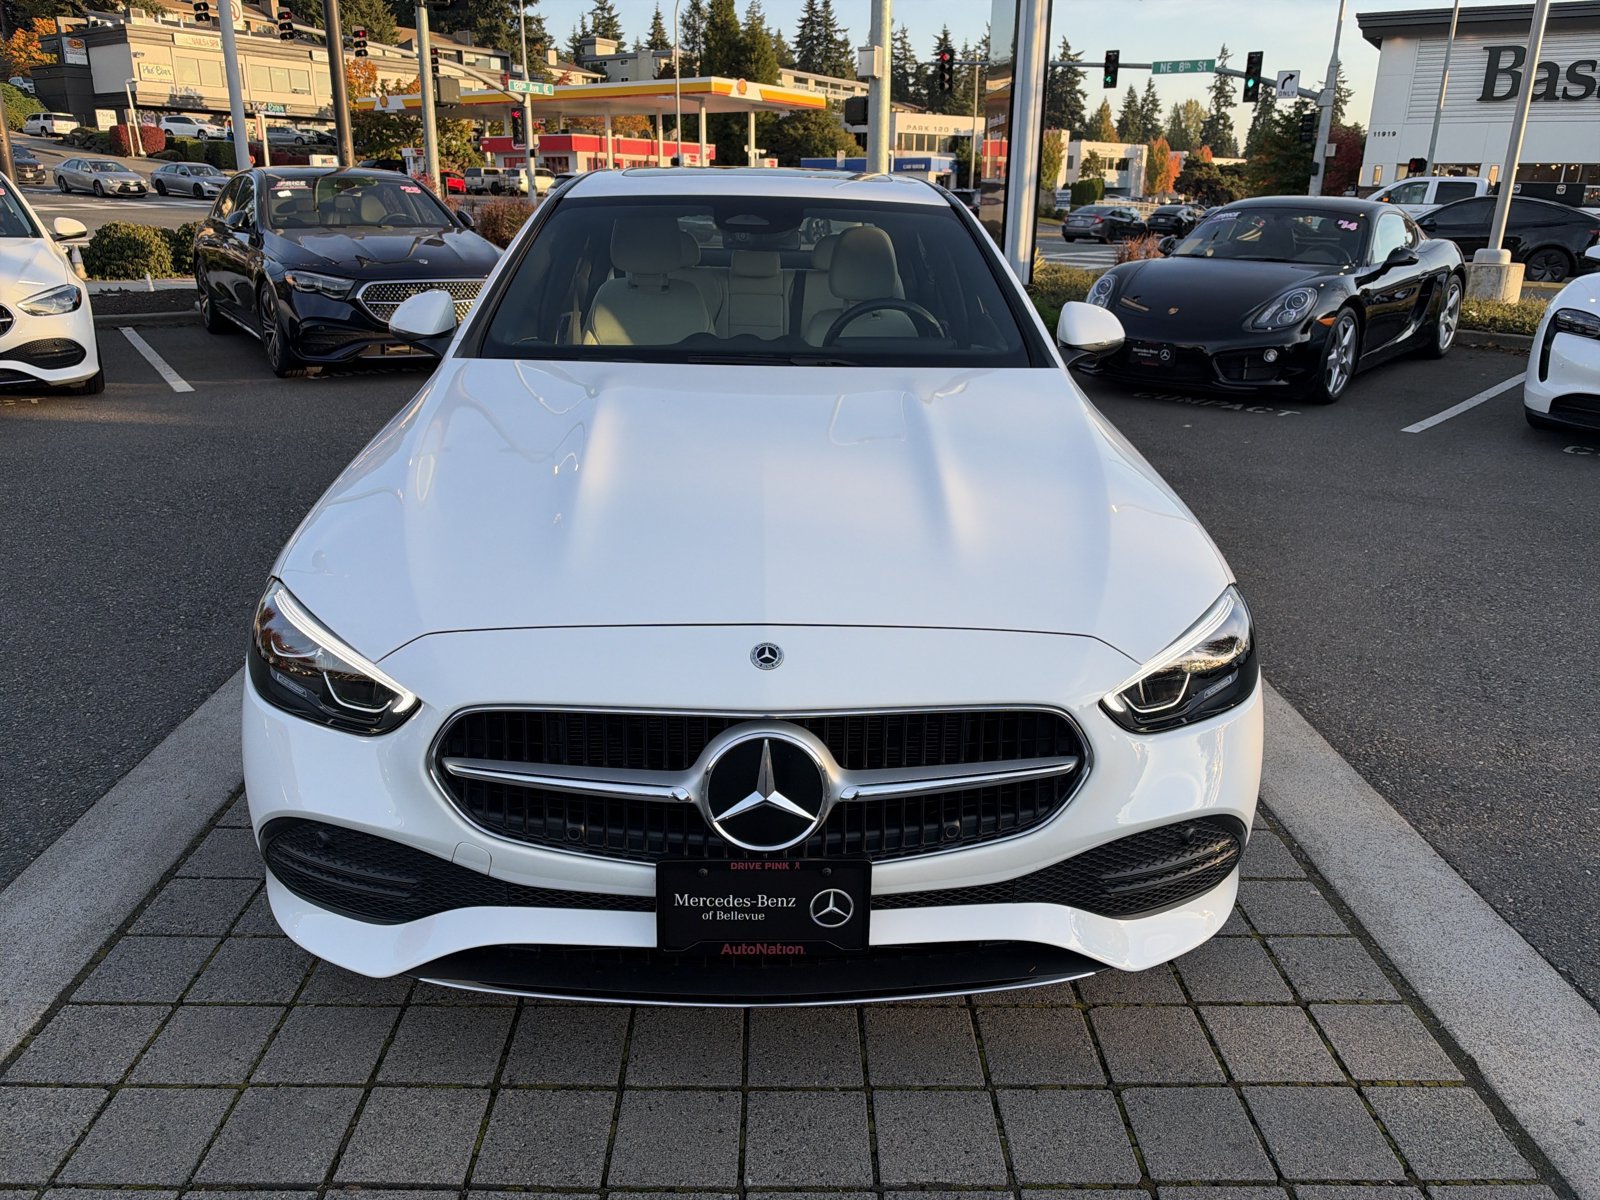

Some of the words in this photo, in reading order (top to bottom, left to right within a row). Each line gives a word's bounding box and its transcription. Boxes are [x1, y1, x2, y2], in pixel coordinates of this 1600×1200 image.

[1160, 62, 1172, 73] NE
[1178, 61, 1191, 72] 8th
[1197, 60, 1207, 72] St
[1476, 45, 1600, 102] Bas
[730, 862, 762, 870] DRIVE
[765, 862, 789, 870] PINK
[673, 893, 797, 908] Mercedes-Benz
[702, 911, 714, 920] of
[716, 911, 765, 920] Bellevue
[721, 943, 804, 955] AutoNation
